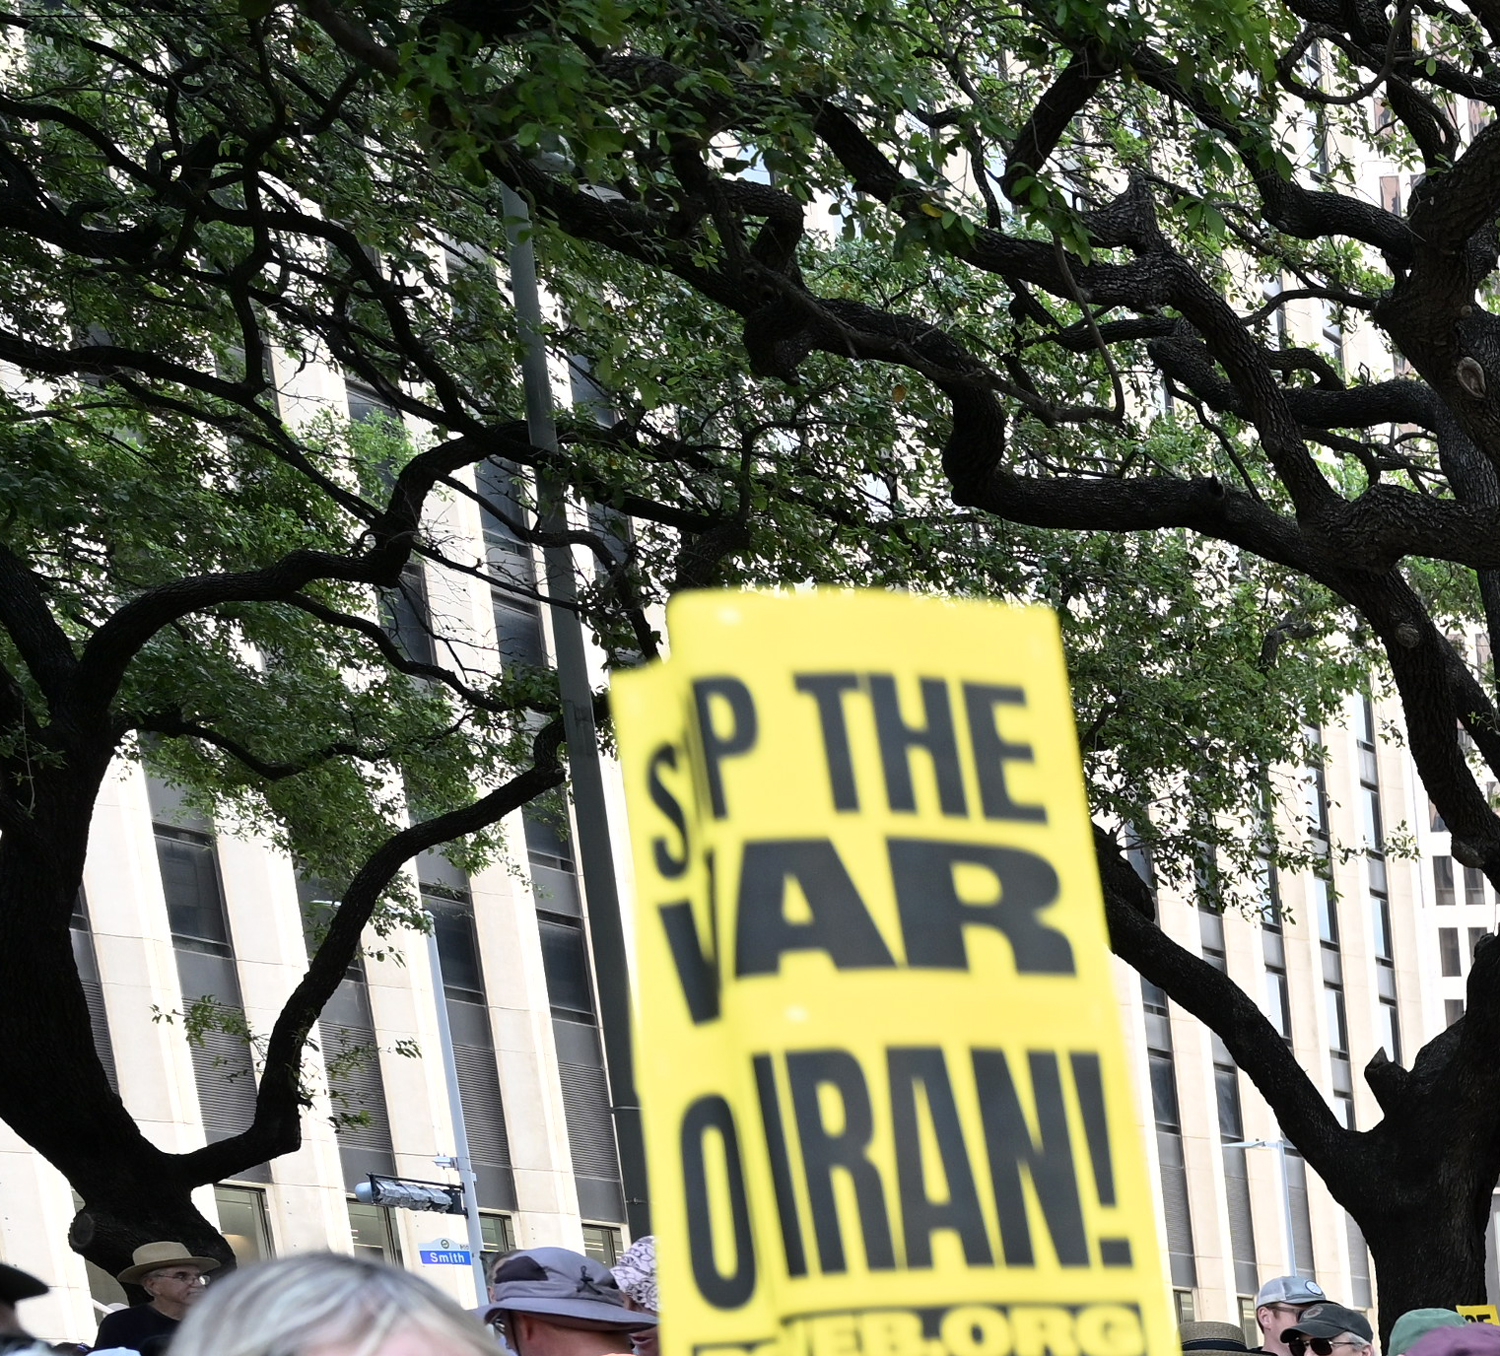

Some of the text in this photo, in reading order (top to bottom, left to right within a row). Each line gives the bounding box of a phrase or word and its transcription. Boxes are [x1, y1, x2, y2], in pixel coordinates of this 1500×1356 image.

[793, 672, 1048, 826] THE
[751, 1045, 1133, 1280] IRAN!
[430, 1252, 465, 1263] Smith
